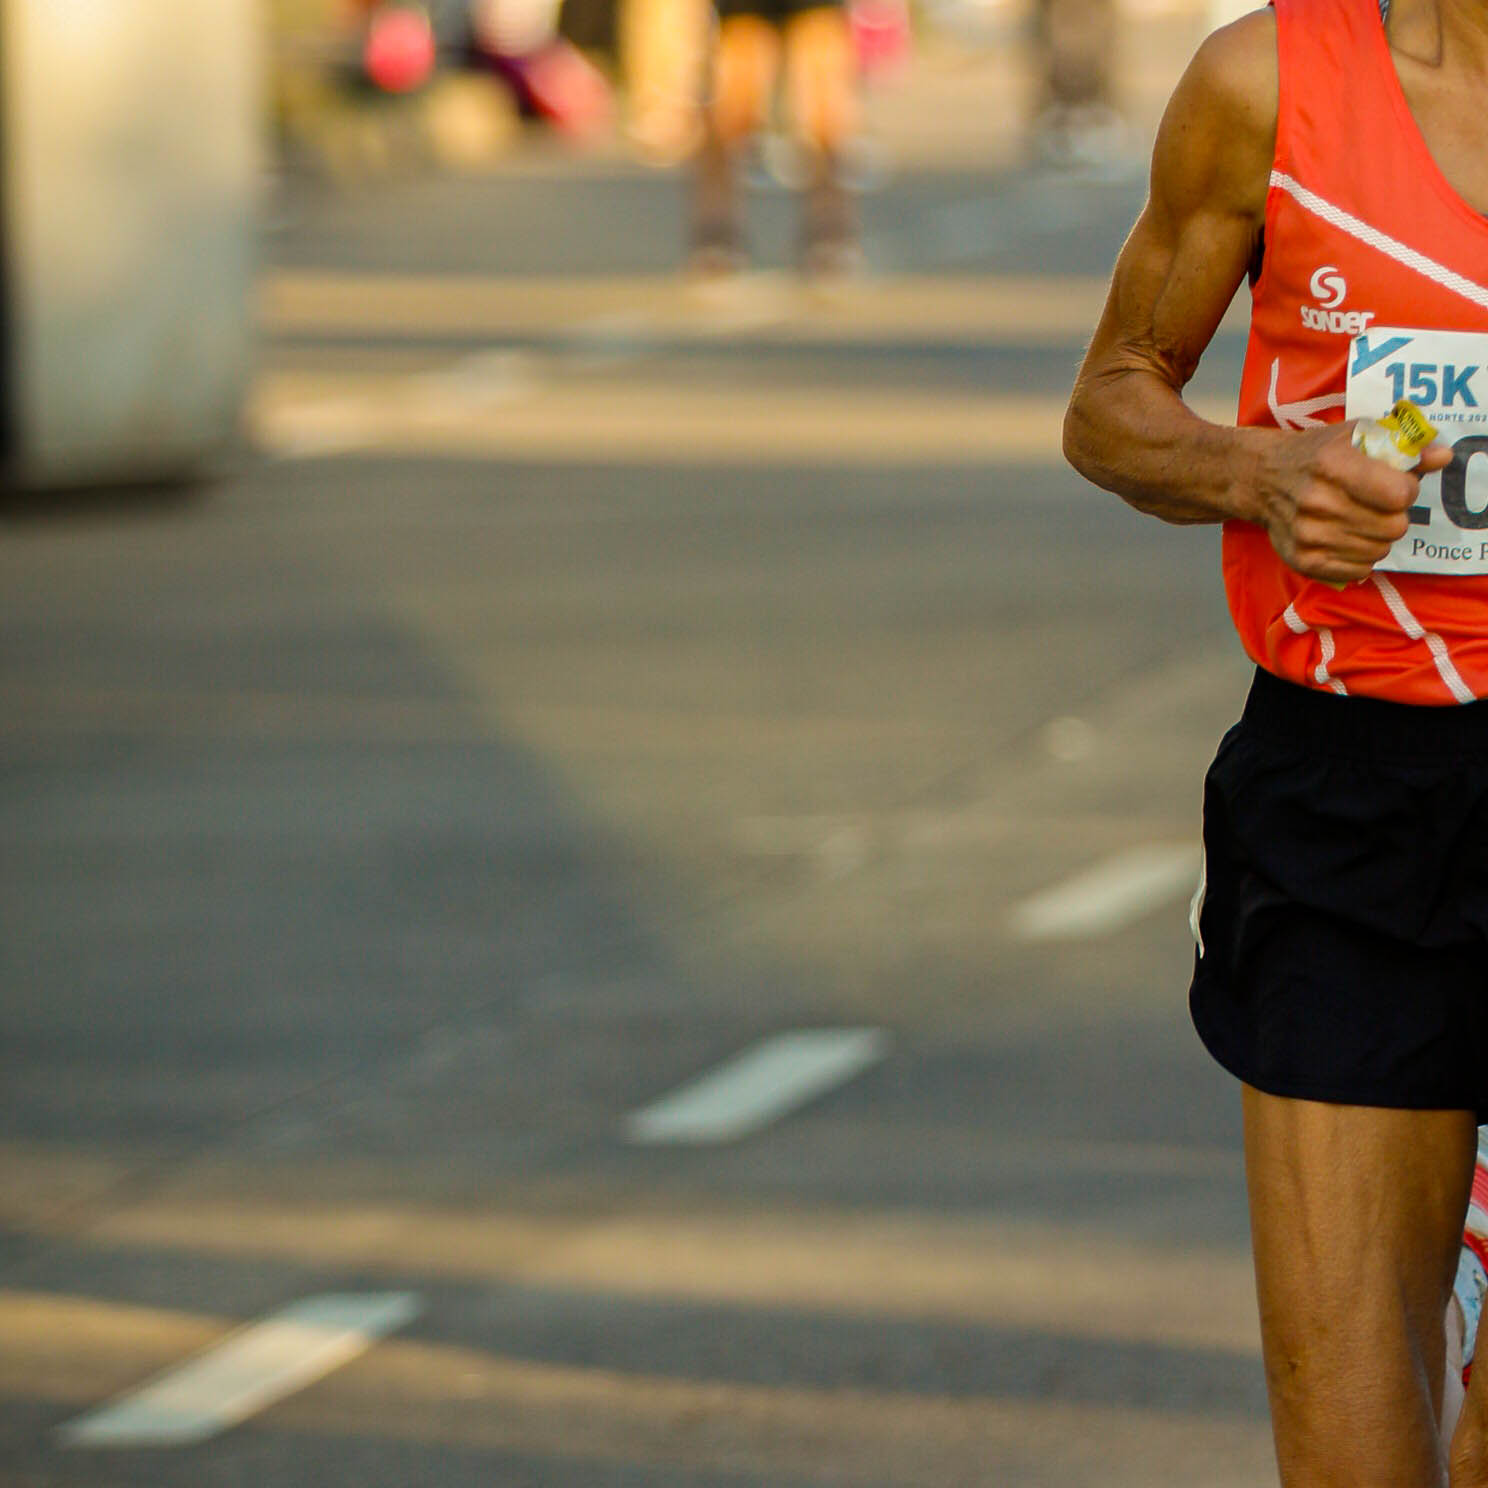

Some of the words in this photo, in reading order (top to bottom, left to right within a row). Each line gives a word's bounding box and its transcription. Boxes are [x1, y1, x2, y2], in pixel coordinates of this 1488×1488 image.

[1385, 362, 1479, 406] 15K
[1429, 413, 1465, 423] NORTE
[1411, 538, 1473, 560] Ponce
